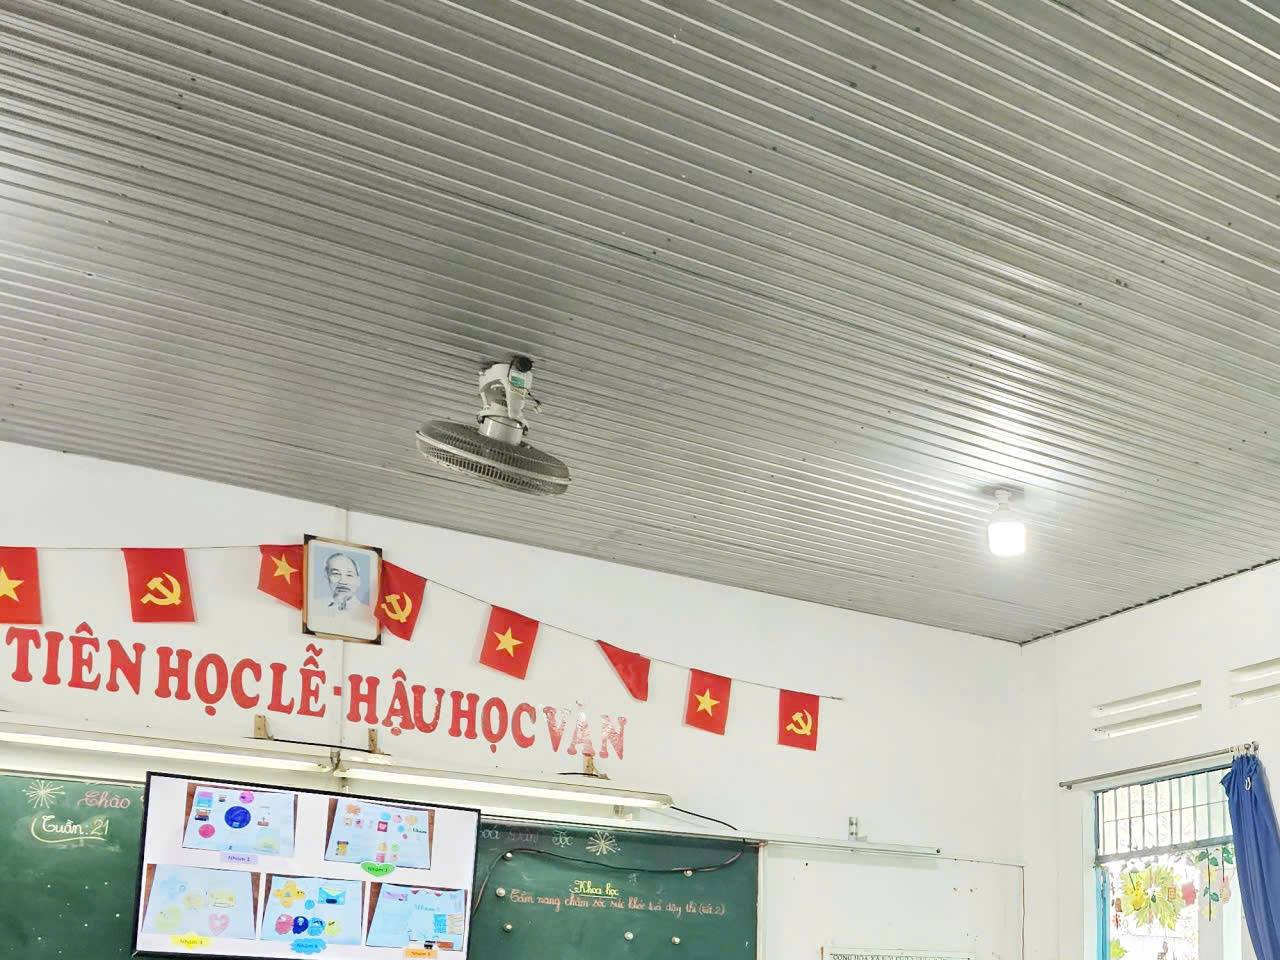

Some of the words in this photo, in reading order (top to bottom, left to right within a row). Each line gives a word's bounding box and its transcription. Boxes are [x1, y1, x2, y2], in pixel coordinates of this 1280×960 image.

[5, 621, 146, 695] TIÊN
[154, 646, 262, 716] HỌC
[266, 643, 327, 718] LỄ
[347, 668, 445, 736] HẬU
[448, 690, 537, 754] HỌC
[91, 819, 109, 836] 21
[569, 880, 602, 895] Khoa
[605, 883, 619, 897] học
[538, 896, 560, 912] nang
